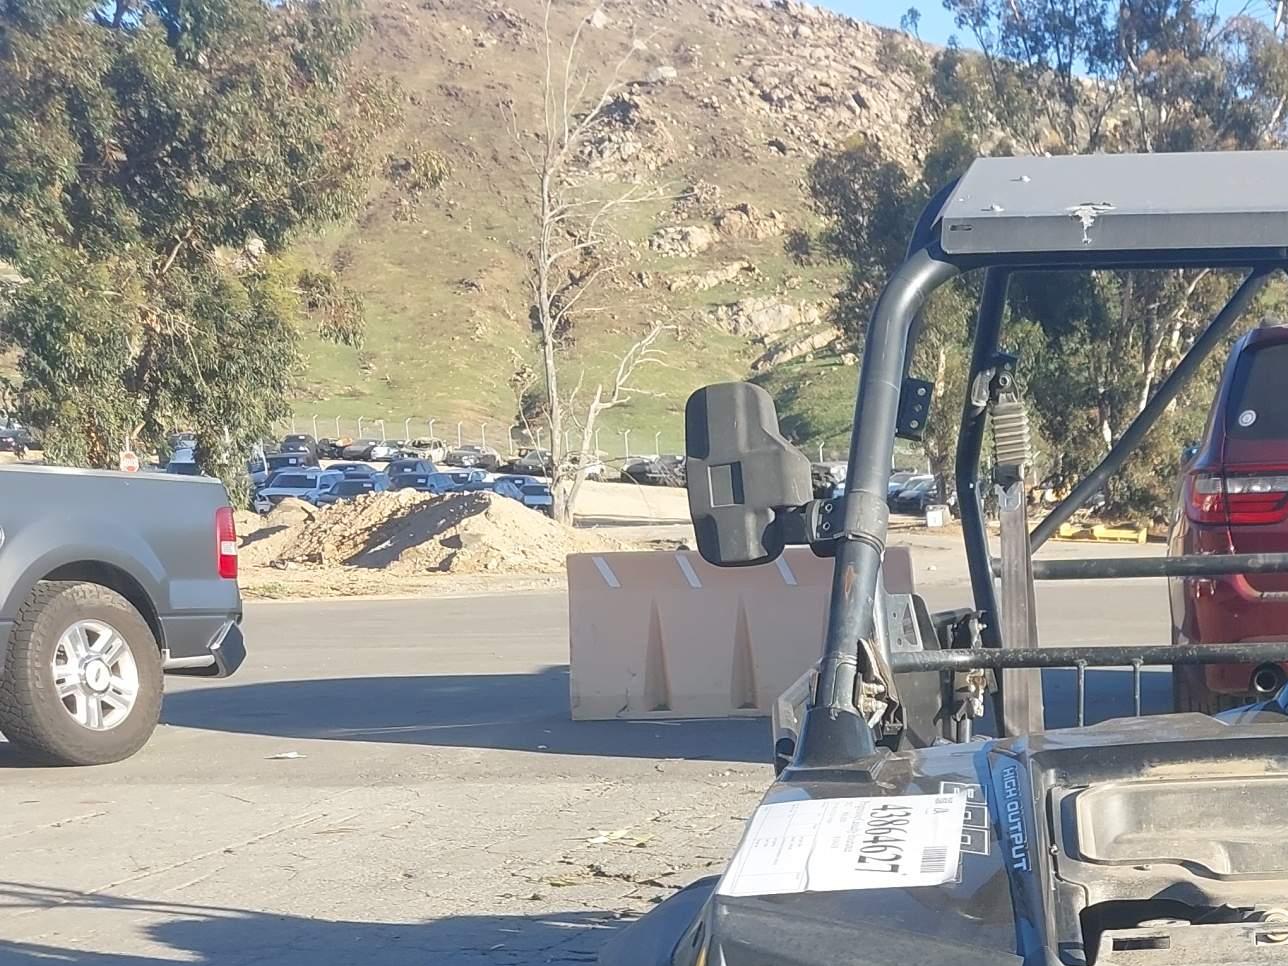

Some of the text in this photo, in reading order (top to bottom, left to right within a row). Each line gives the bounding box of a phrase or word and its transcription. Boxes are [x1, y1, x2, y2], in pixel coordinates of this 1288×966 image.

[853, 804, 914, 874] 43864627
[1002, 764, 1032, 873] HIGH OUTPUT
